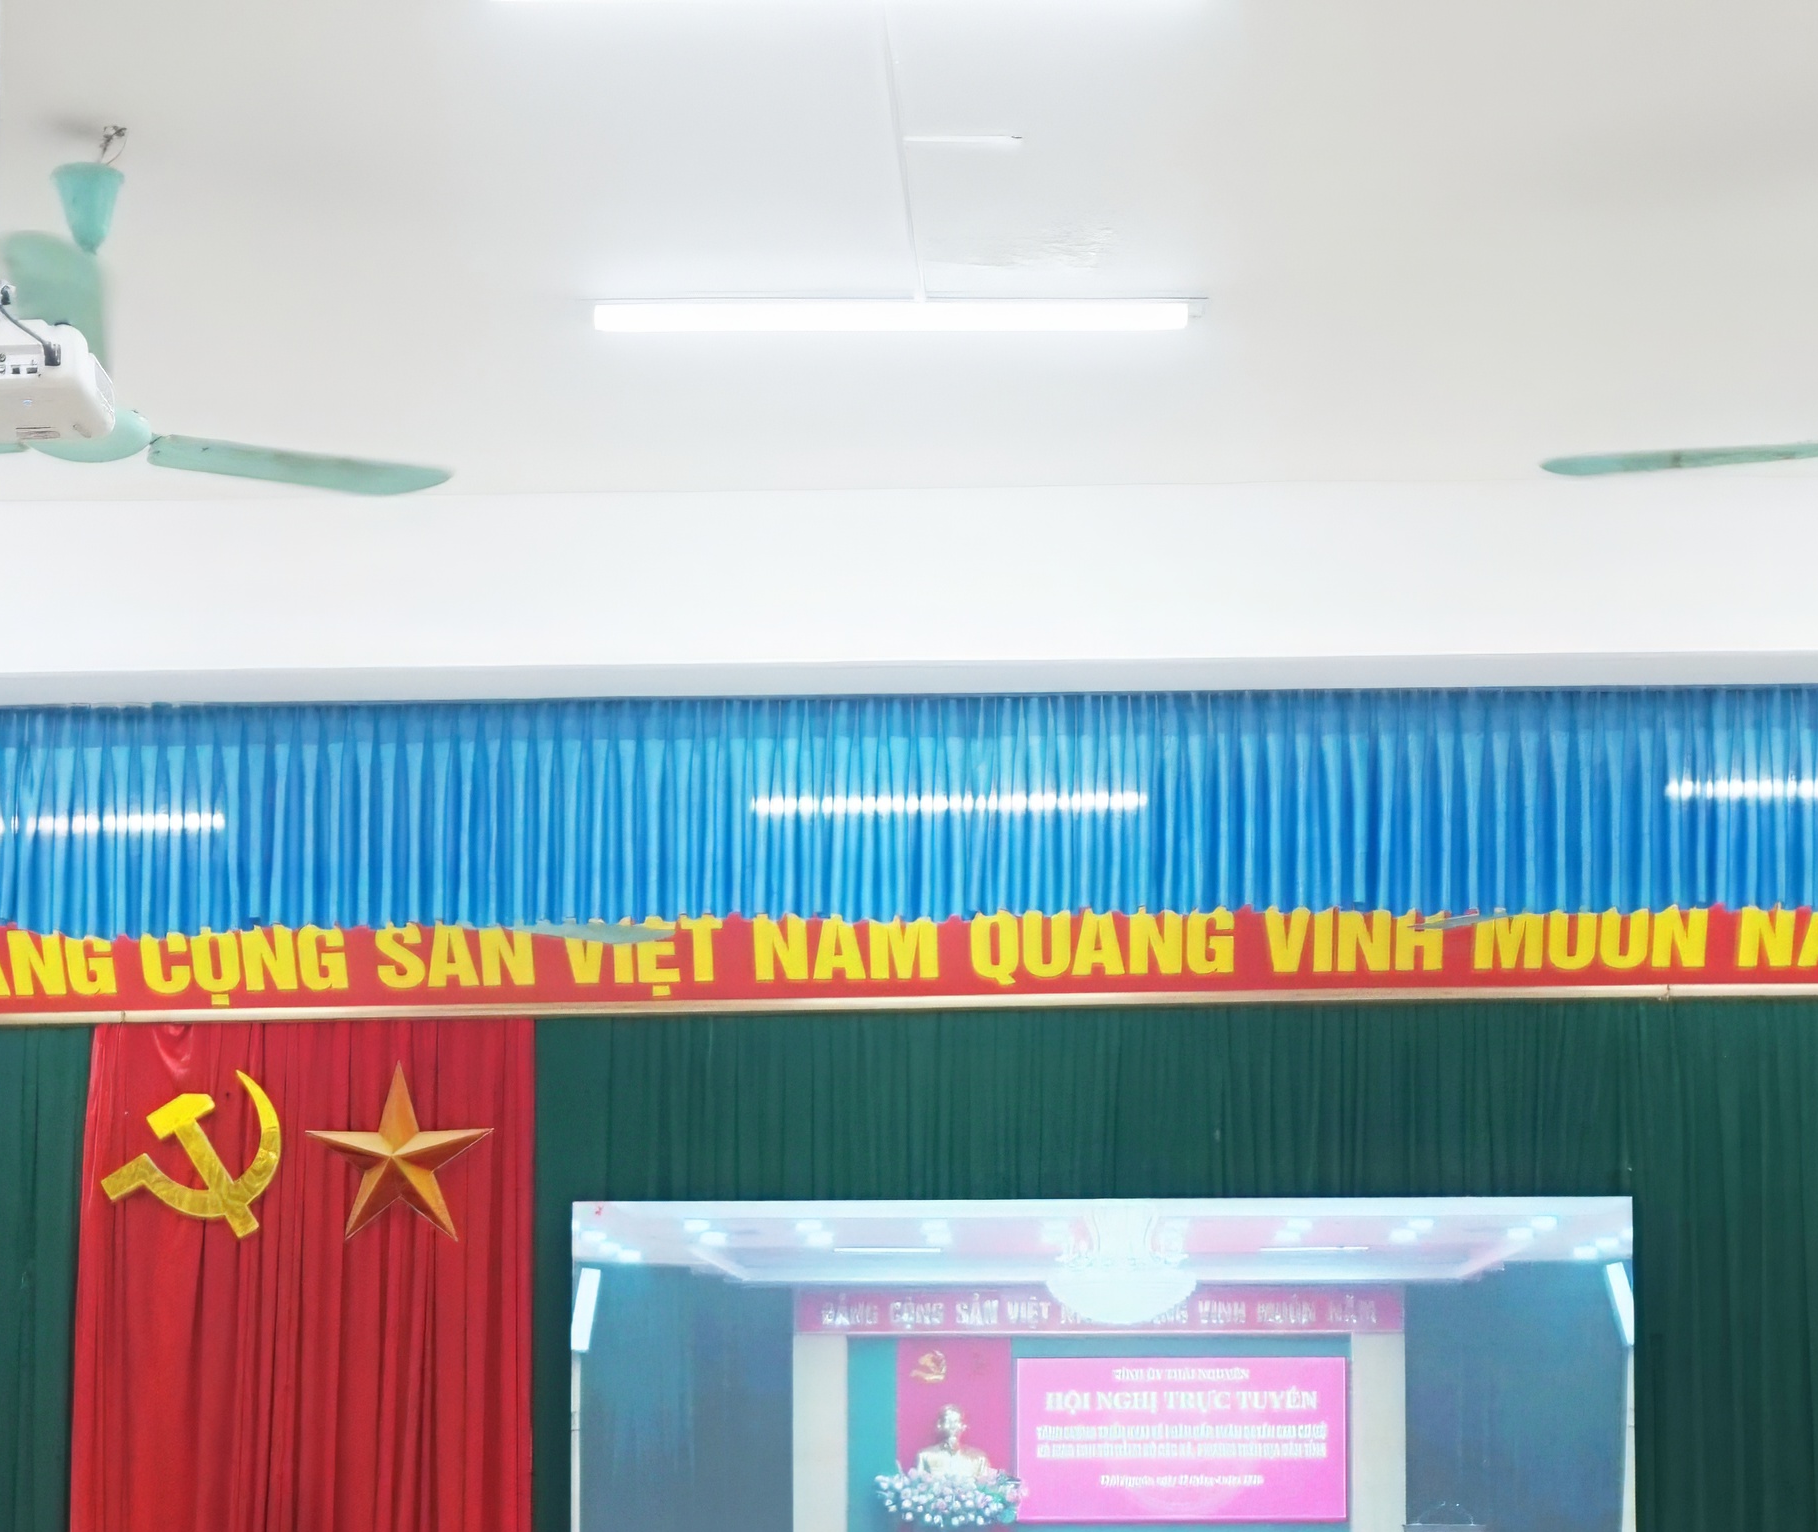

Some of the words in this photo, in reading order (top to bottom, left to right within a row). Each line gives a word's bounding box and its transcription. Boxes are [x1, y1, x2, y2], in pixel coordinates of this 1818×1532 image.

[754, 913, 940, 982] NAM
[969, 906, 1235, 985] QUANG
[1264, 906, 1444, 973] VINH
[1045, 1390, 1090, 1415] HỘI
[1096, 1391, 1157, 1414] NGHỊ
[1164, 1390, 1231, 1414] TRỰC
[1236, 1385, 1318, 1411] TUYẾN
